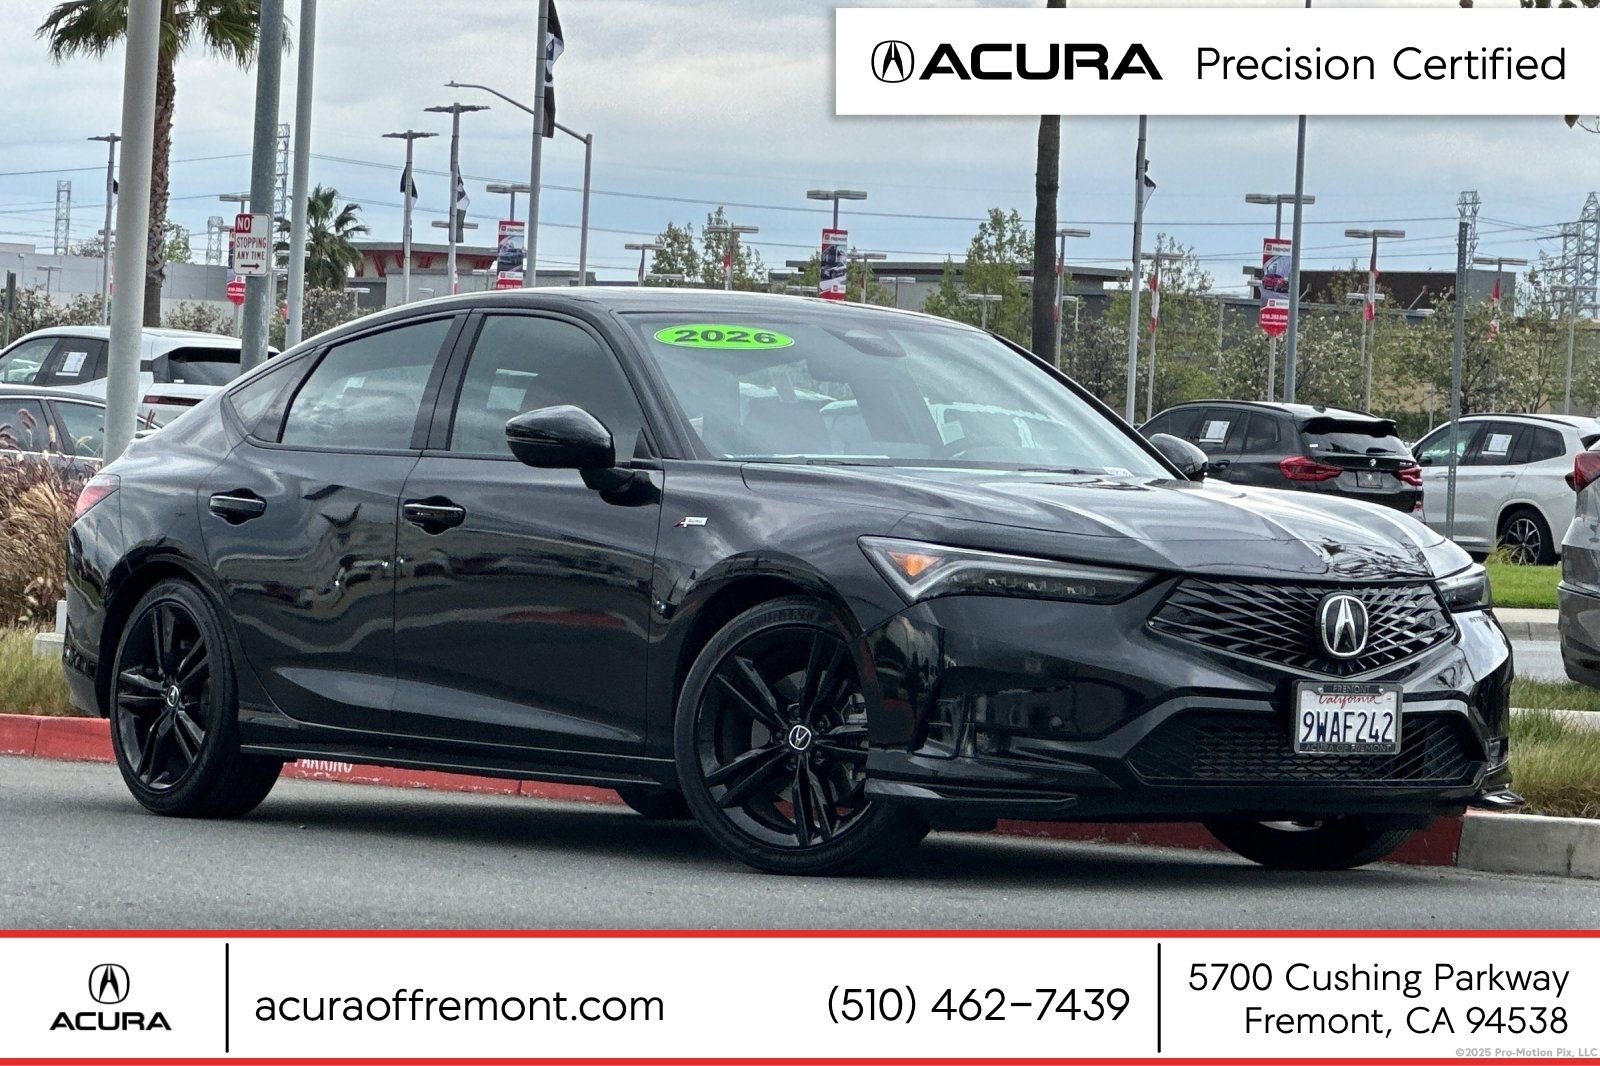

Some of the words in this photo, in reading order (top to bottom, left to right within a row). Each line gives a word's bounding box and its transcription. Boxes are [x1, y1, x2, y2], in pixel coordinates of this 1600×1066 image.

[237, 217, 251, 231] NO
[236, 237, 267, 248] STOPPING
[237, 251, 250, 260] ANY
[251, 251, 265, 260] TIME
[674, 329, 778, 344] 2026
[1333, 684, 1371, 693] FREMONT
[1319, 695, 1382, 709] California
[1301, 711, 1394, 743] 9WAF242
[1305, 744, 1334, 752] ACURA
[1336, 744, 1350, 752] OF
[1351, 744, 1392, 752] FREMONT
